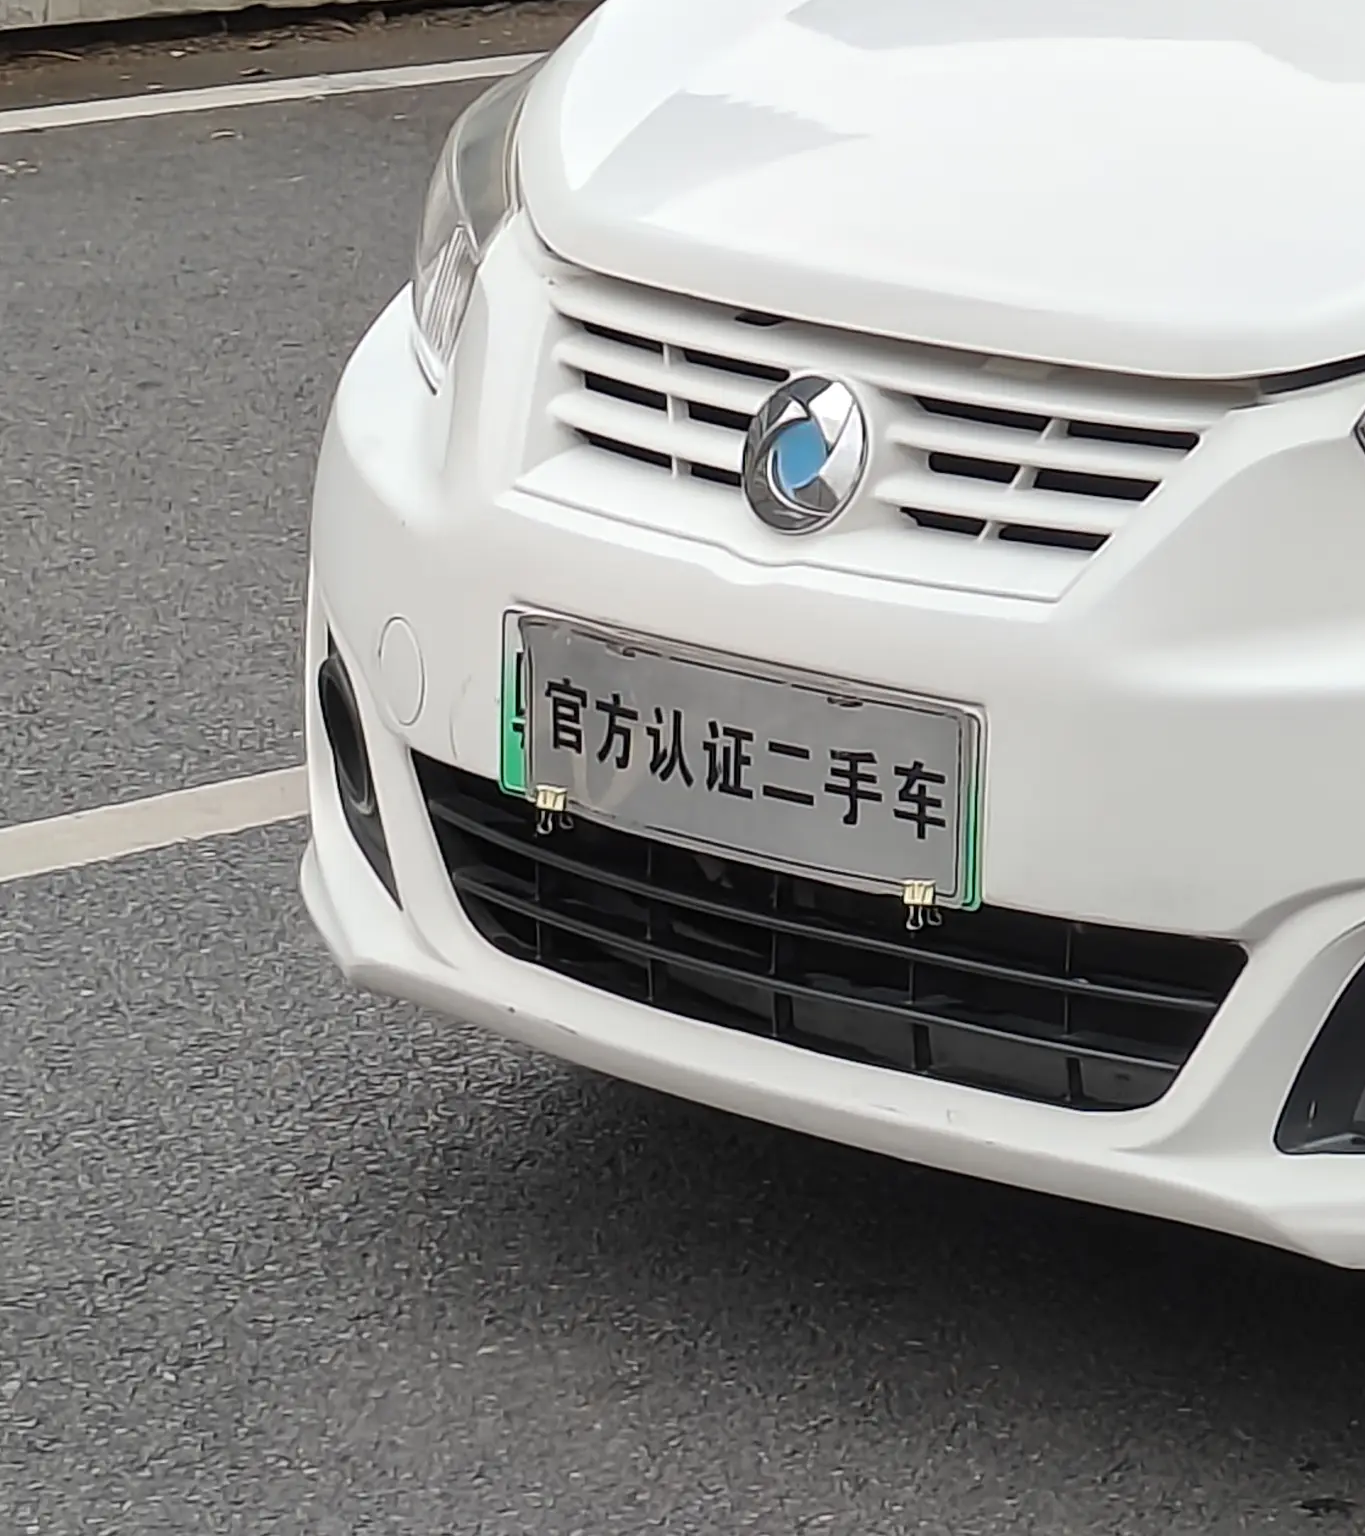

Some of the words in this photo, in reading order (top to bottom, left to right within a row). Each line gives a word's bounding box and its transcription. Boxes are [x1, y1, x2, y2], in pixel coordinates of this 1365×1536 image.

[544, 678, 947, 840] 官方认证二手车
